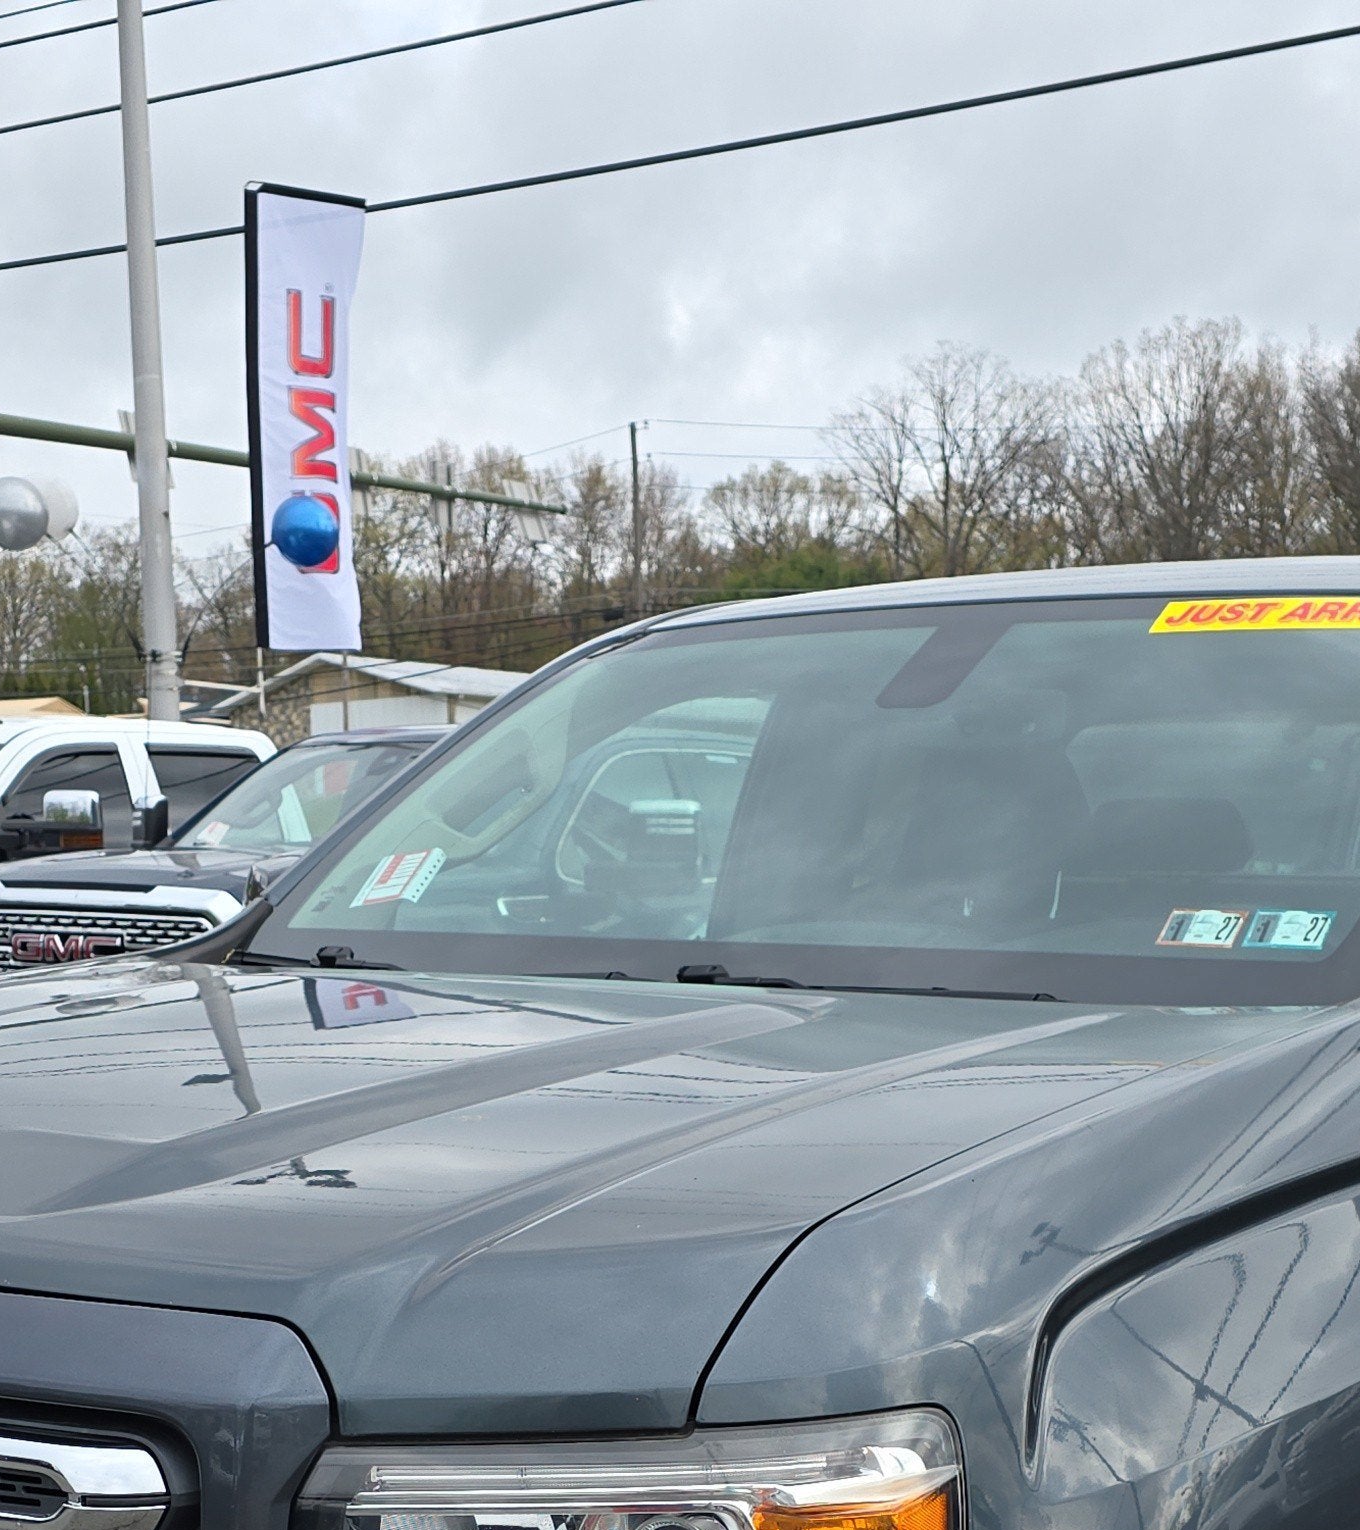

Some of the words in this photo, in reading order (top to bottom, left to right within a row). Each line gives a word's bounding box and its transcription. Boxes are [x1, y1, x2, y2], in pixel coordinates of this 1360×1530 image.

[286, 287, 340, 574] MC
[1165, 602, 1282, 626] JUST
[1214, 916, 1241, 941] 27
[1303, 917, 1329, 943] 27
[11, 931, 123, 963] GMC
